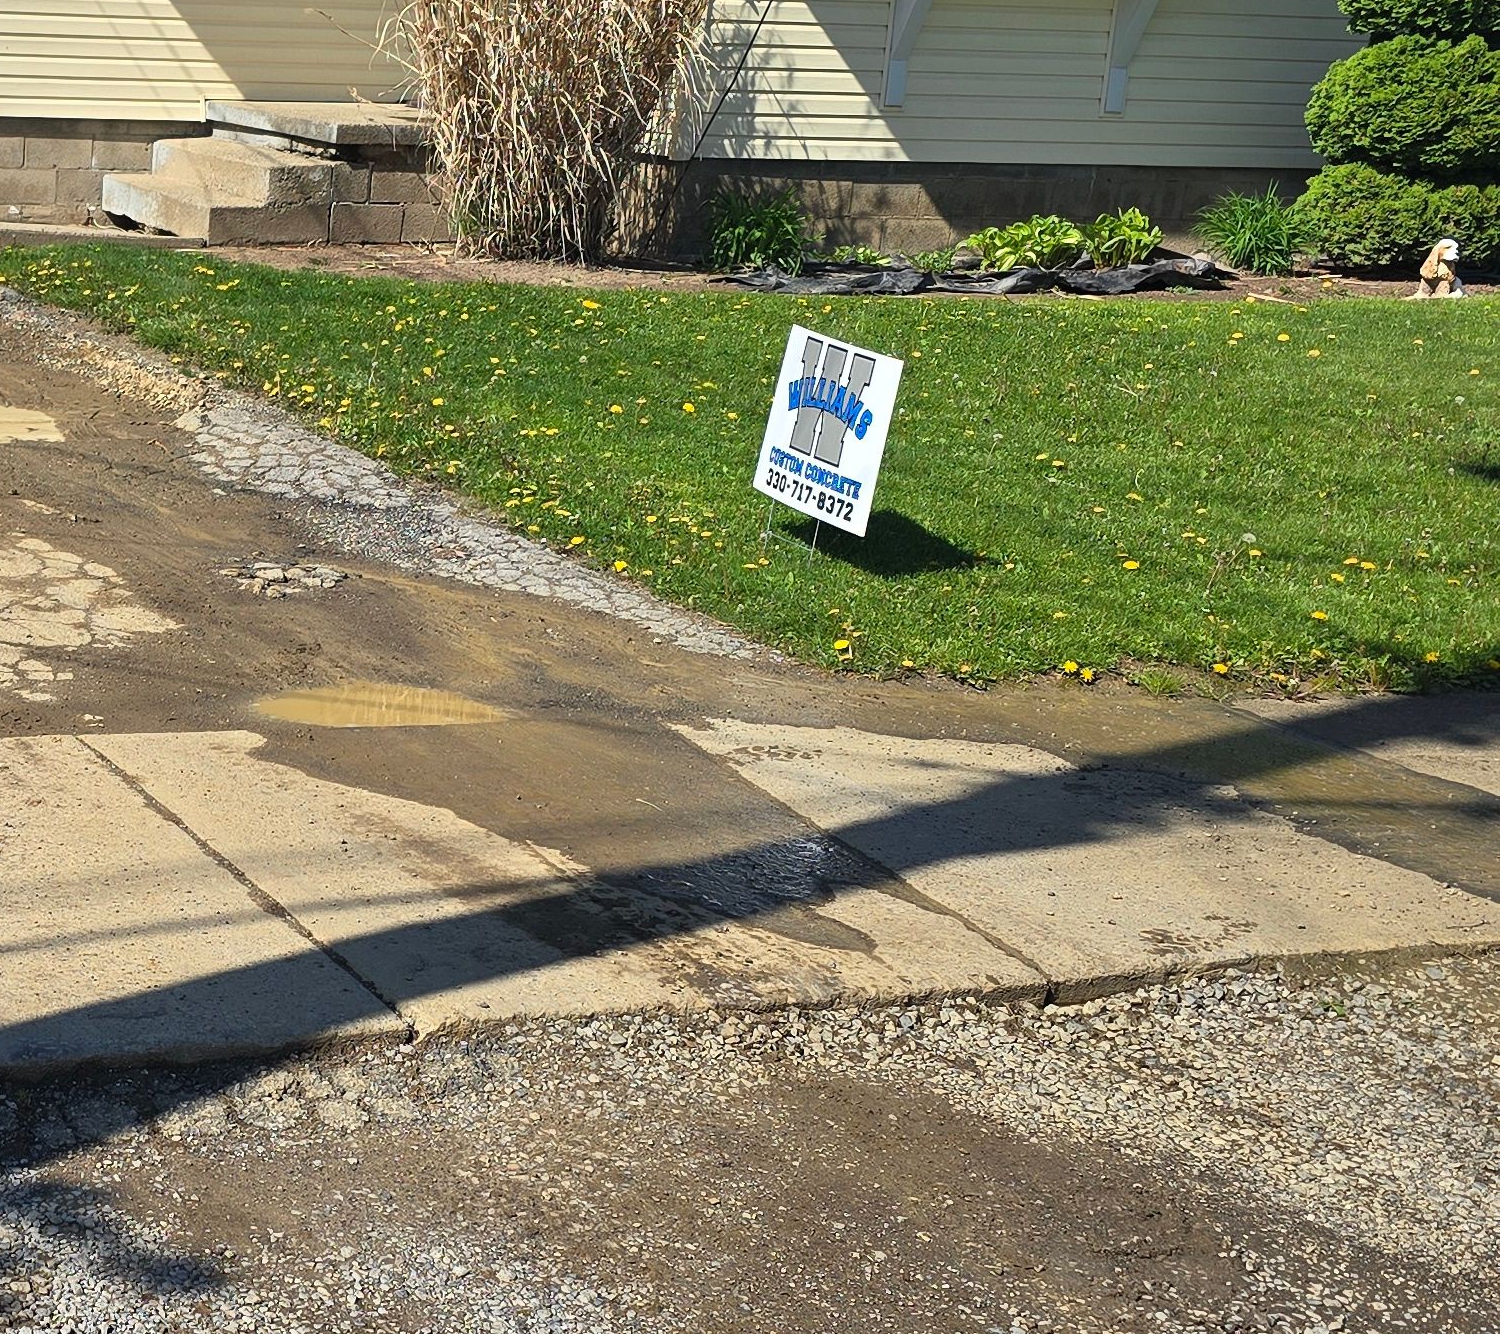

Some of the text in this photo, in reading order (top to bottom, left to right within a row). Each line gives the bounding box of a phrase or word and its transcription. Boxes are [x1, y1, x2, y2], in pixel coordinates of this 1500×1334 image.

[788, 376, 873, 440] WILLIAMS
[766, 468, 854, 522] 330-717-8372
[770, 446, 862, 500] CUSTOM CONCRETE
